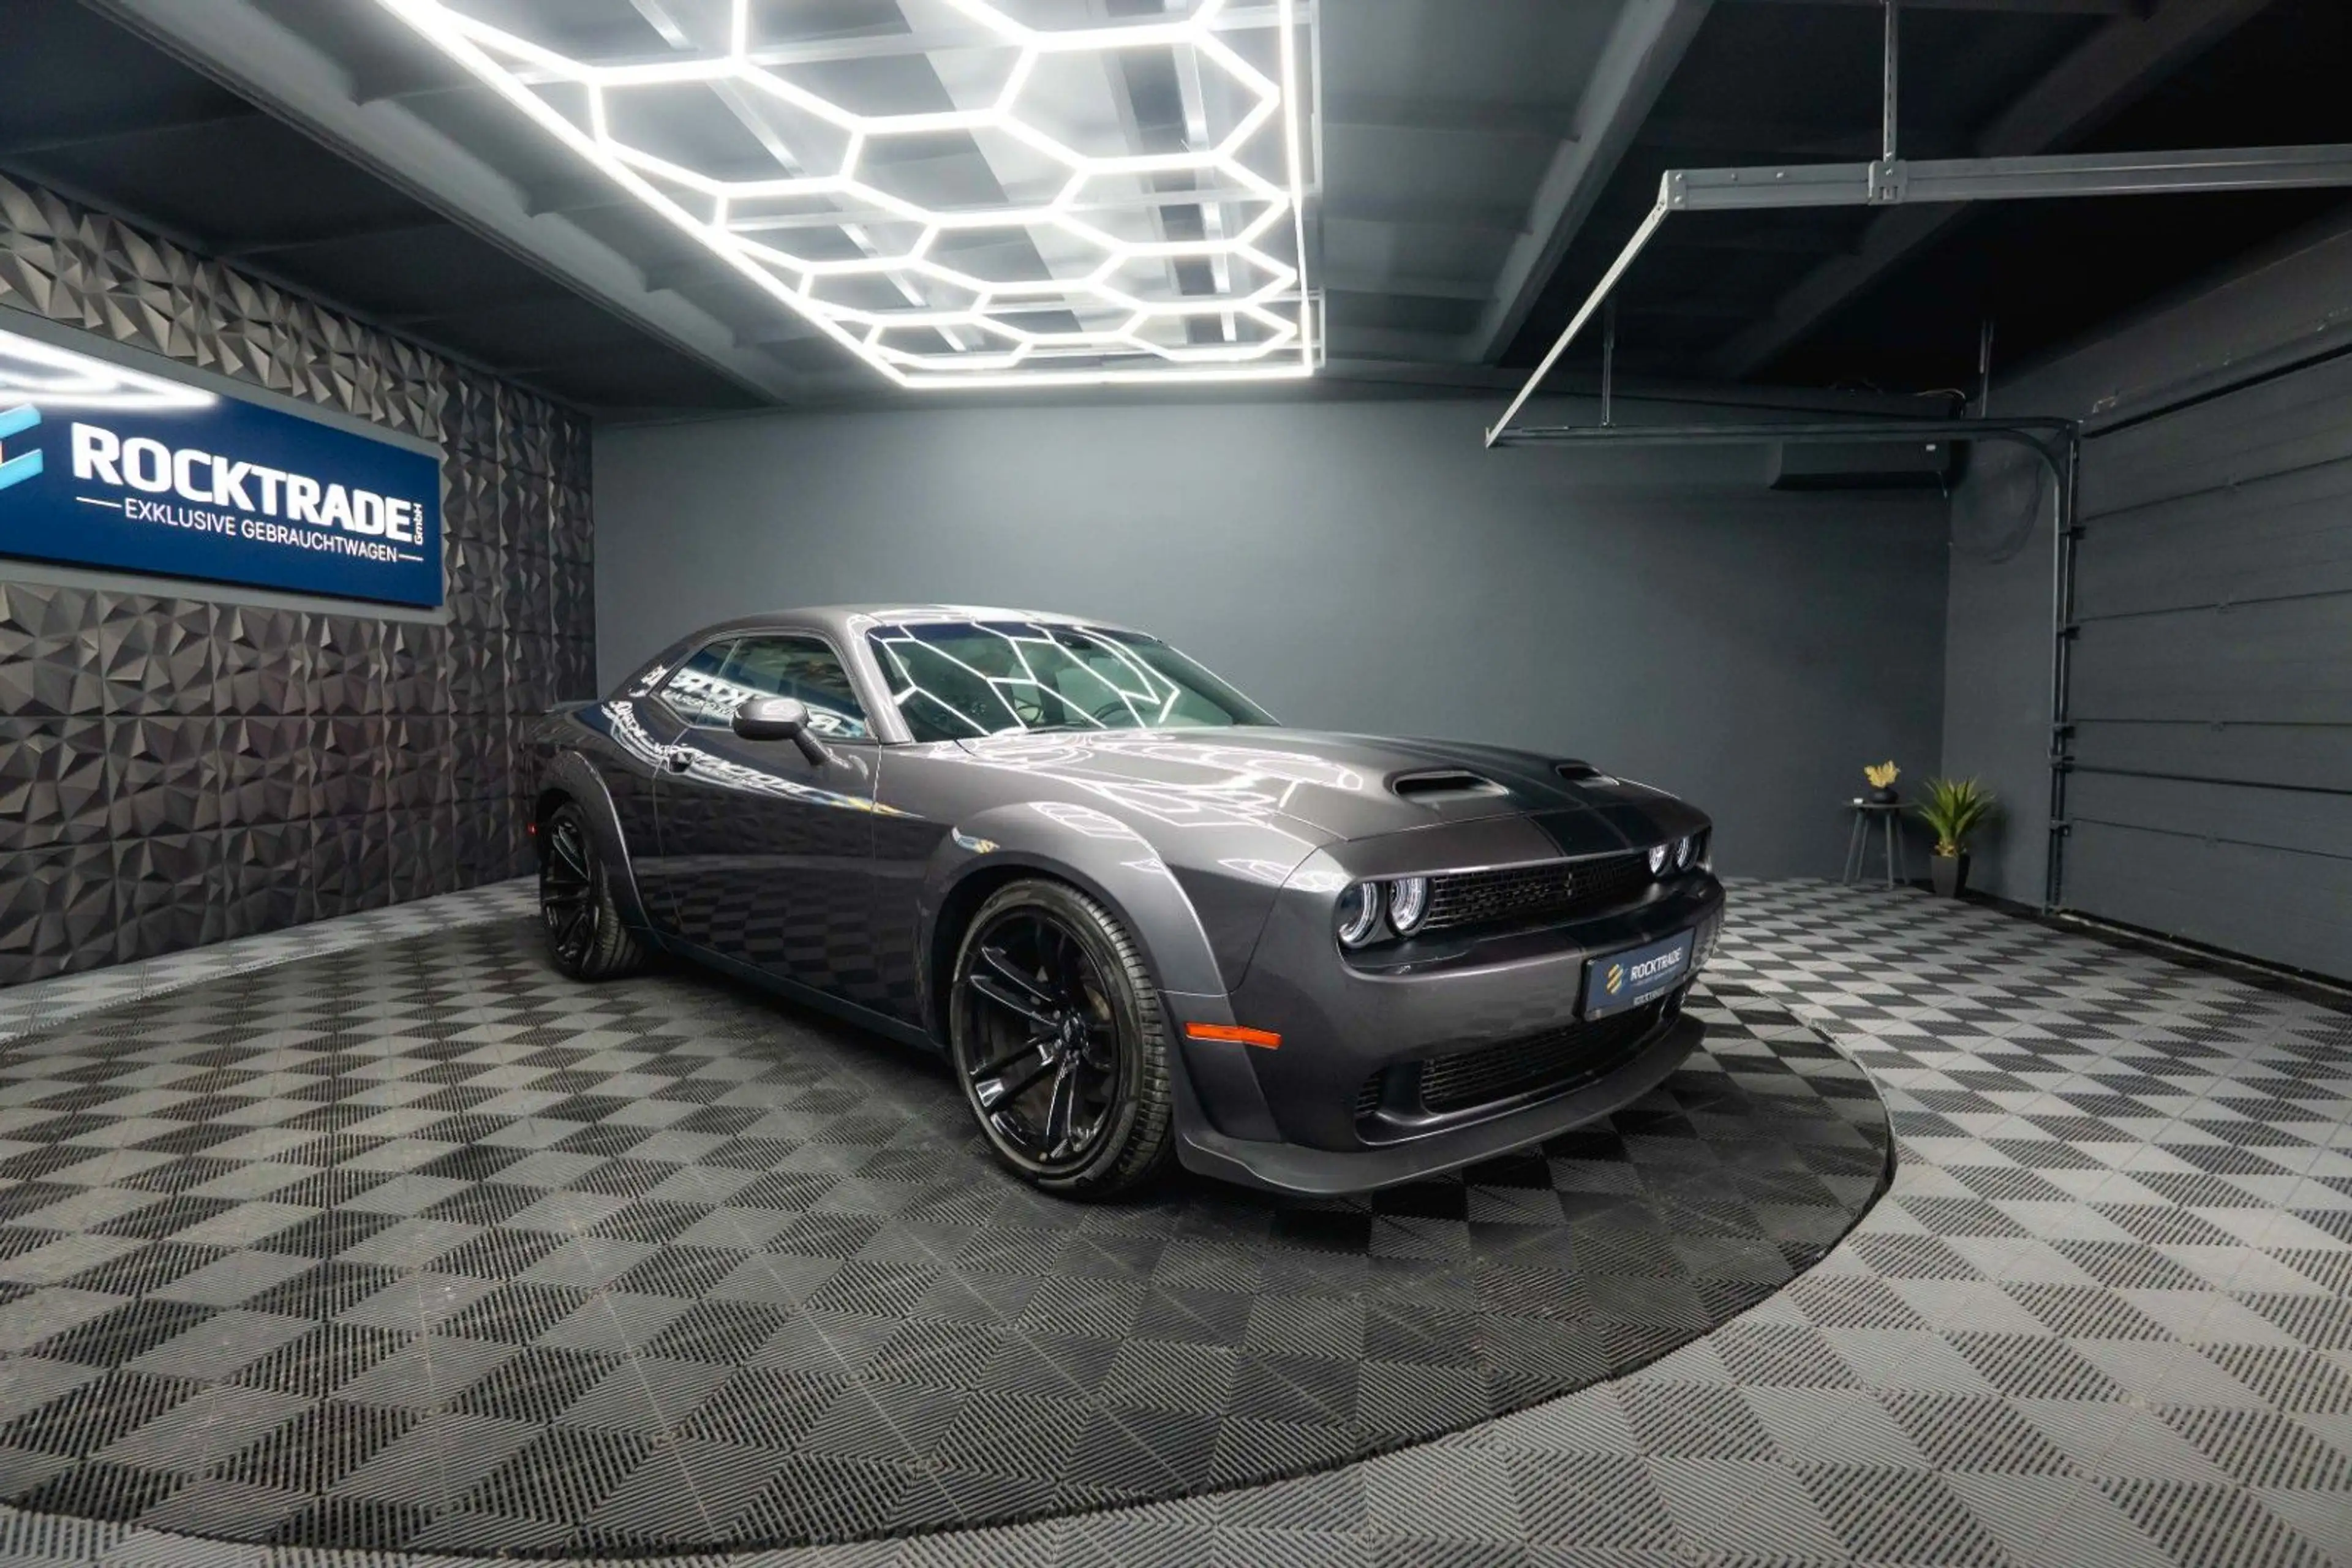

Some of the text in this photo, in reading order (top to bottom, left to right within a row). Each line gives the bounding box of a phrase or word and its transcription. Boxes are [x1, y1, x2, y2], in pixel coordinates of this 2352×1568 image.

[71, 422, 412, 542] ROCKTRADE
[124, 497, 397, 562] EXKLUSIVE GEBRAUCHTWAGEN
[413, 503, 423, 546] GmbH
